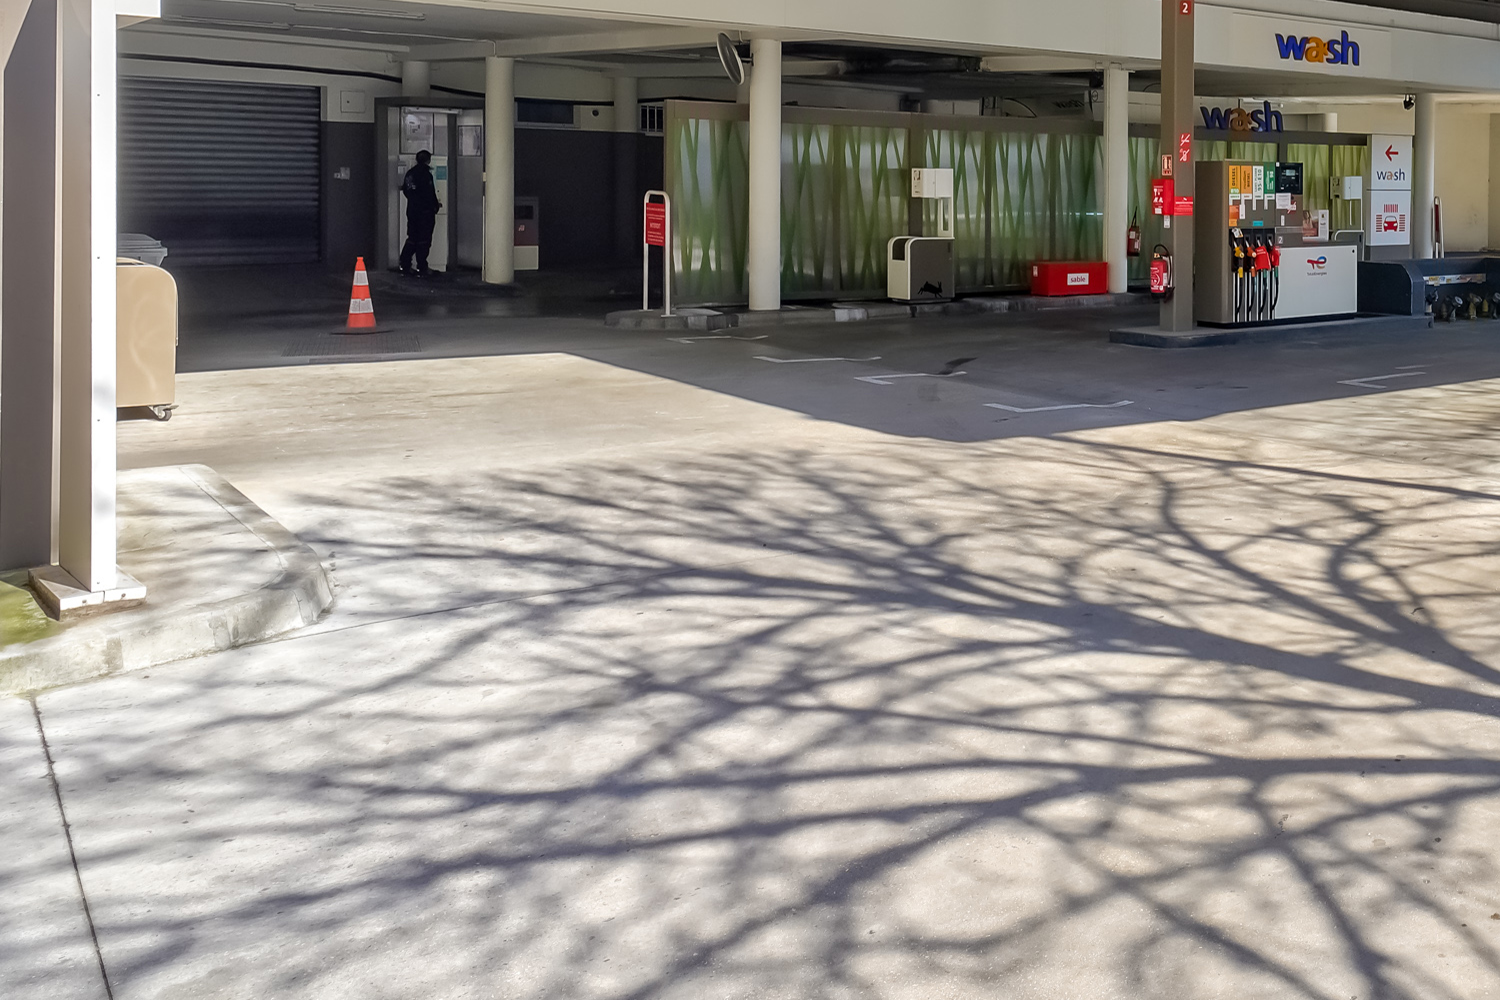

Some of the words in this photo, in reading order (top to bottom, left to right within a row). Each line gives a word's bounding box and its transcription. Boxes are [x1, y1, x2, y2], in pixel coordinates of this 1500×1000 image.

[1182, 2, 1188, 13] 2
[1275, 30, 1360, 66] wash
[1200, 100, 1284, 133] wash
[1376, 168, 1406, 181] wash
[1278, 236, 1283, 244] 2
